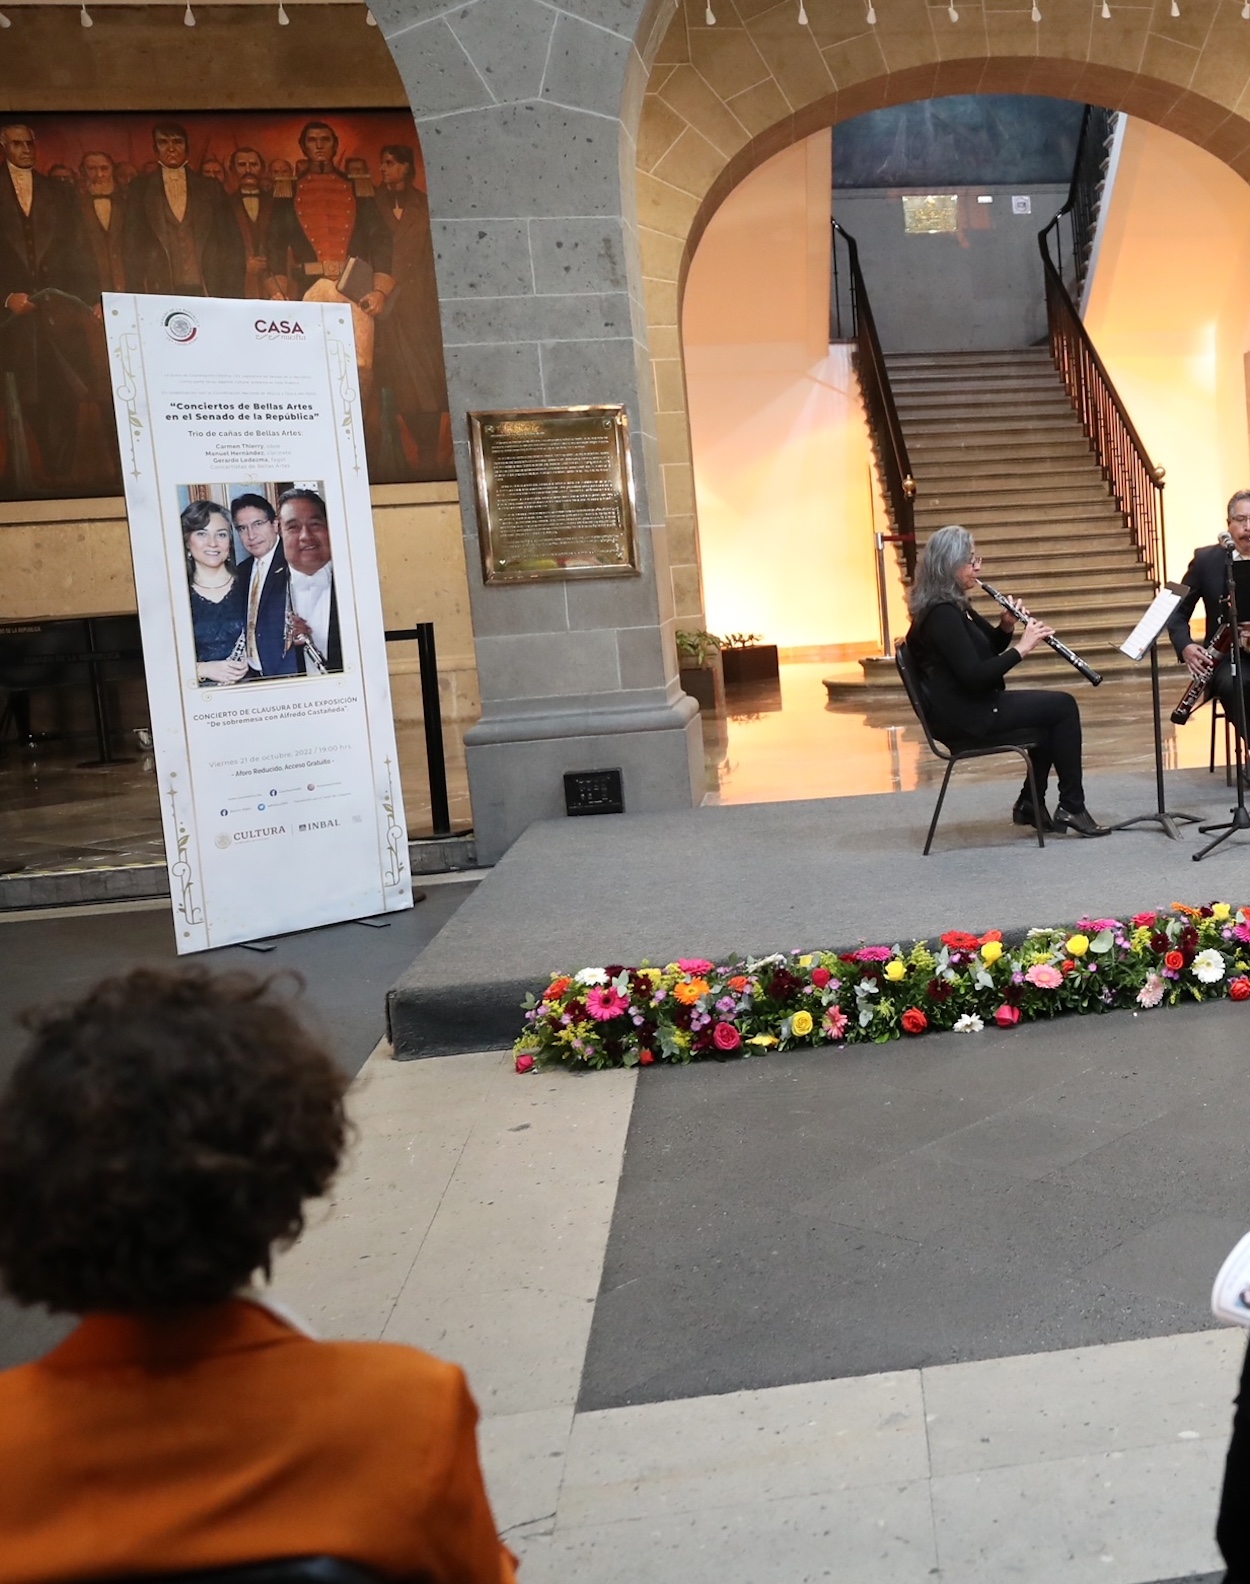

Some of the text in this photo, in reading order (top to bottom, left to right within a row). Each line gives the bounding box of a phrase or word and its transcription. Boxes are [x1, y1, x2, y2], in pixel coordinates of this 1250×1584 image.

[254, 319, 305, 334] CASA
[238, 402, 250, 411] de
[253, 402, 284, 411] Bellas
[286, 402, 313, 411] Artes
[182, 413, 192, 421] el
[195, 413, 235, 421] Senado
[238, 413, 250, 421] de
[253, 413, 262, 421] la
[193, 710, 238, 721] CONCIERTO
[251, 704, 291, 714] CLAUSURA
[315, 696, 358, 708] EXPOSICIÓN
[222, 716, 263, 726] sobremesa
[280, 710, 306, 719] Alfredo
[209, 758, 239, 768] Viernes
[250, 755, 260, 763] de
[295, 748, 313, 757] 2022
[235, 769, 252, 777] Aforo
[285, 762, 305, 770] Acceso
[306, 758, 331, 767] Gratuito
[233, 825, 286, 841] CULTURA
[308, 819, 341, 831] INBAL
